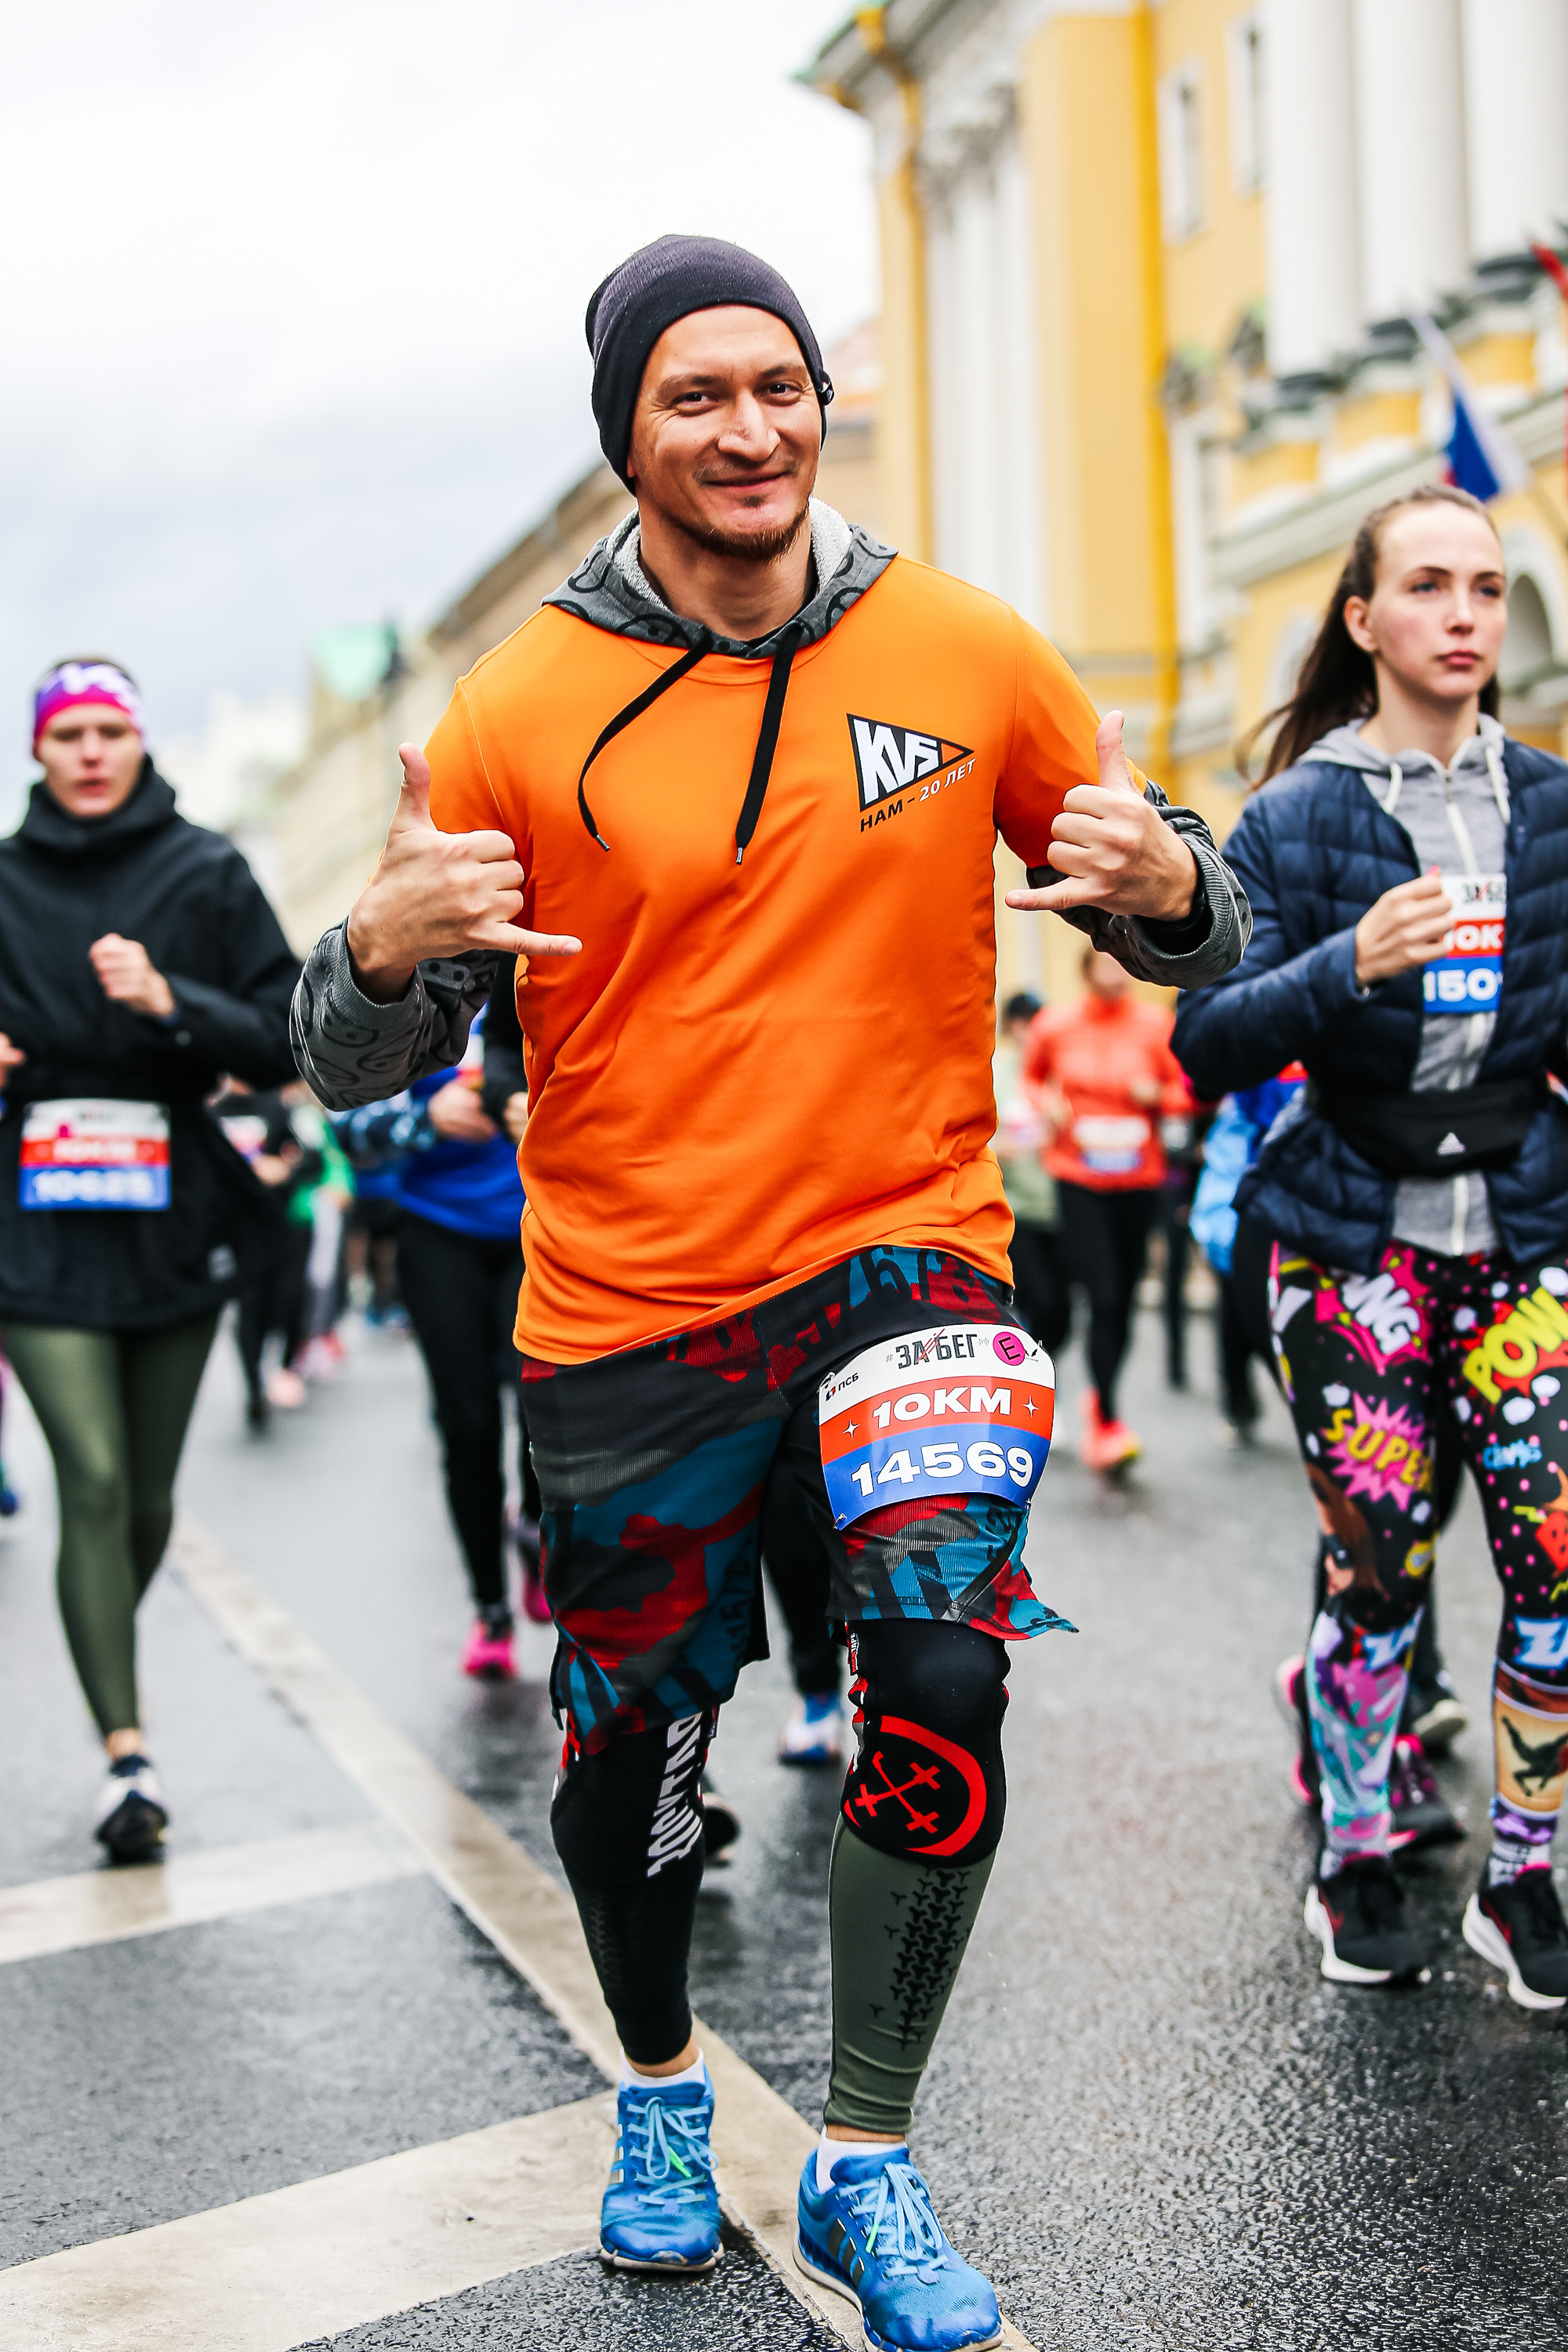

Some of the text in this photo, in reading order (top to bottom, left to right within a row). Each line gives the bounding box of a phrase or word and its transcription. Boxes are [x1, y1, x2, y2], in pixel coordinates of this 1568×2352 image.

[853, 718, 939, 805] KVS
[860, 798, 903, 833] НАМ
[919, 779, 941, 802] 20
[944, 758, 976, 788] ЛЕТ
[1423, 967, 1504, 1003] 150
[838, 1372, 859, 1392] ПСБ
[873, 1386, 1011, 1428] 10КМ
[851, 1441, 1034, 1497] 14569
